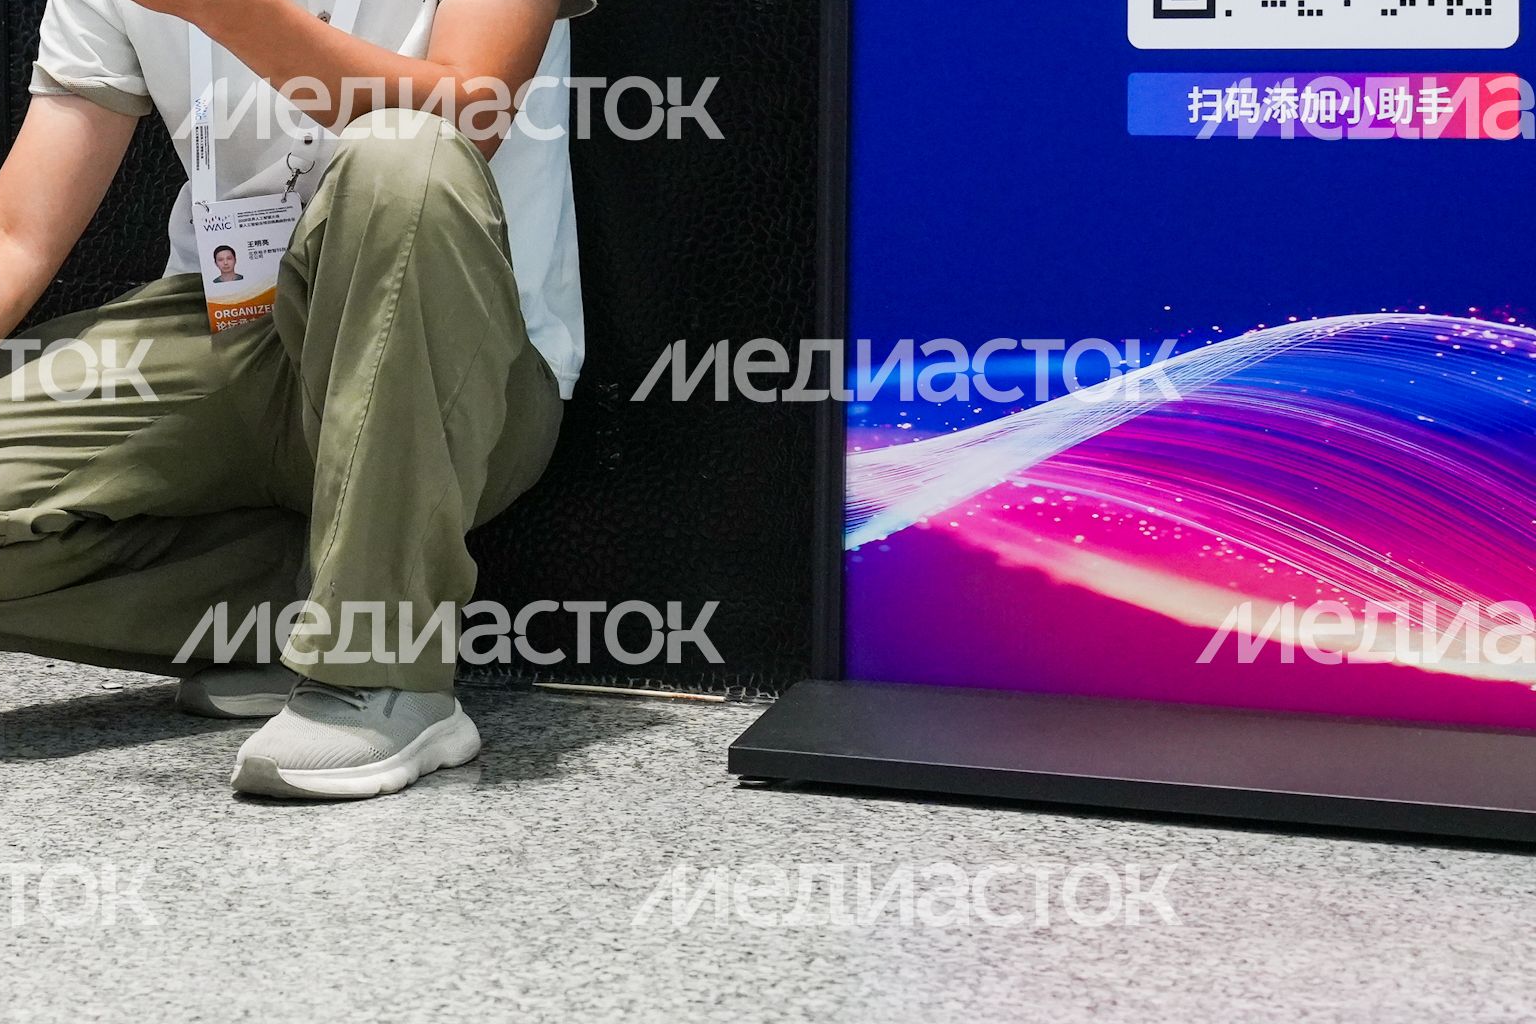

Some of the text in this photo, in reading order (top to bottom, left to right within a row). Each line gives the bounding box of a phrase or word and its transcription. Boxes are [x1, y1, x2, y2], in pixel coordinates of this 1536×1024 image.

[1186, 85, 1454, 126] 扫码添加小助手
[203, 221, 232, 232] WAIC
